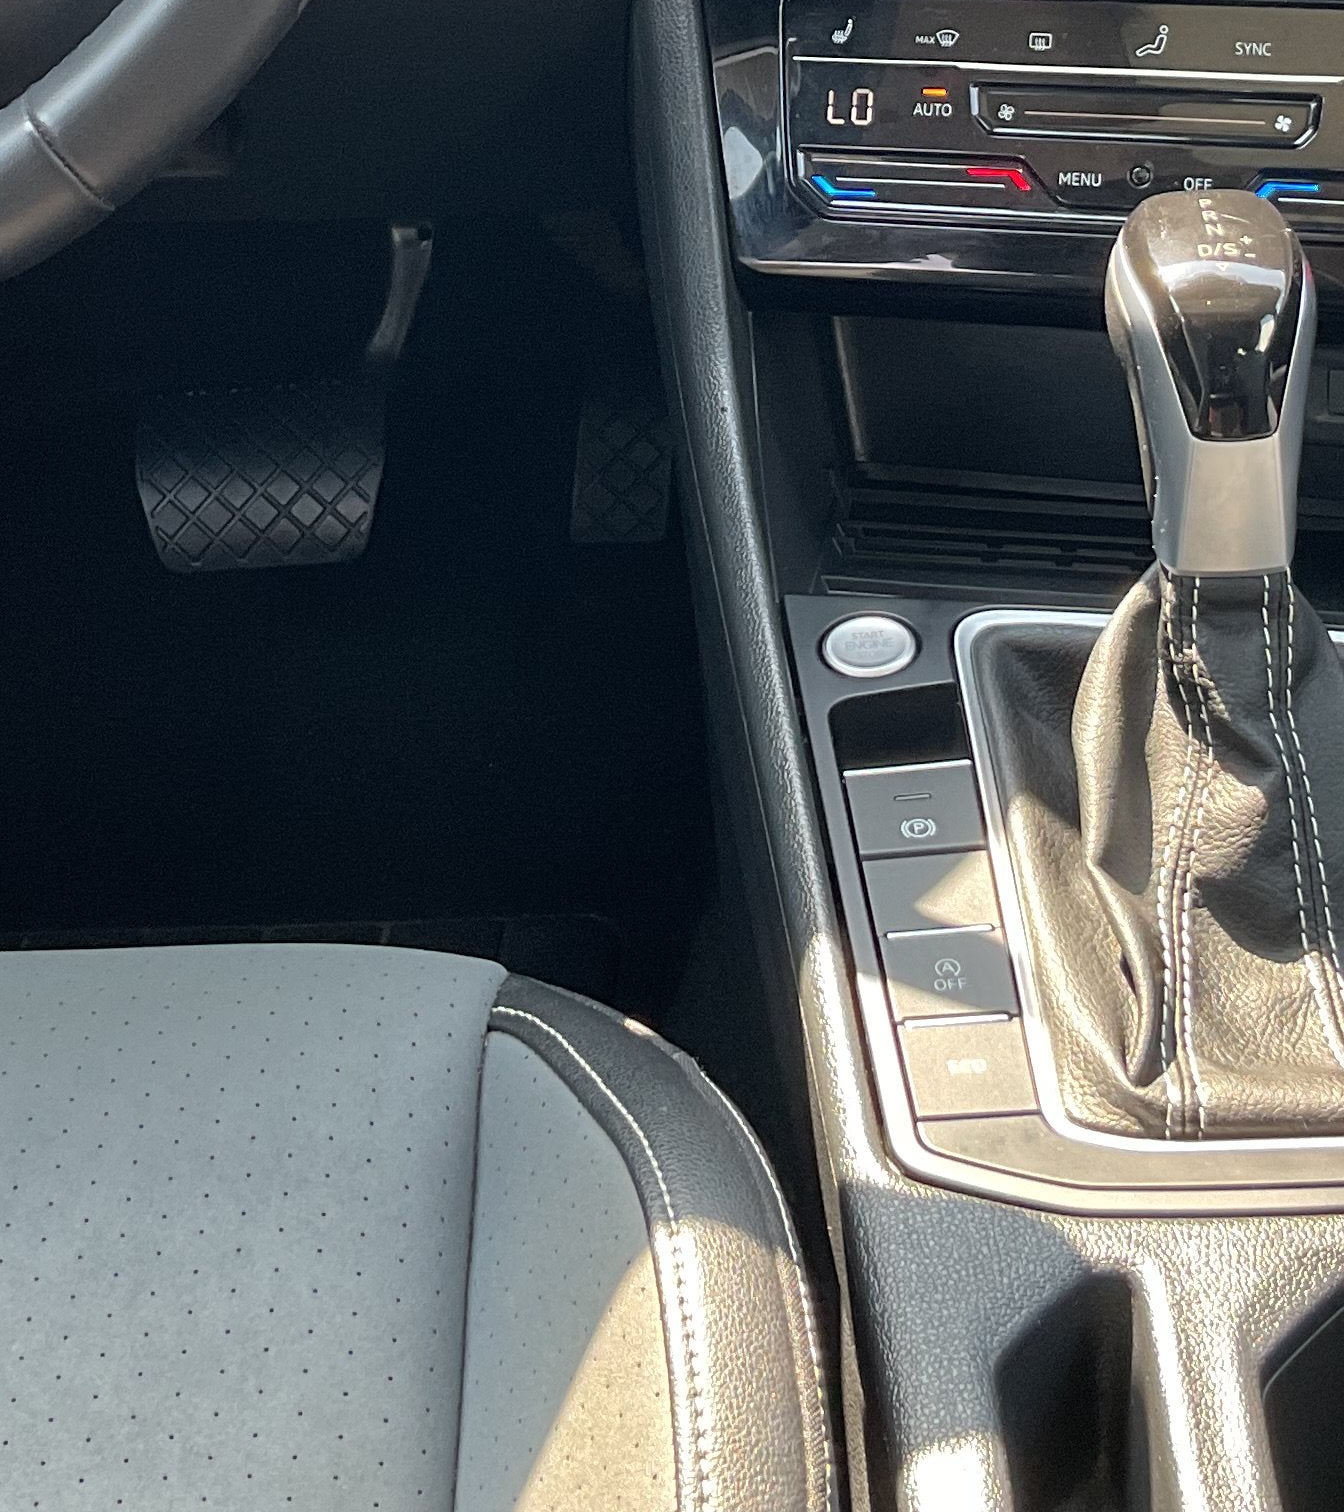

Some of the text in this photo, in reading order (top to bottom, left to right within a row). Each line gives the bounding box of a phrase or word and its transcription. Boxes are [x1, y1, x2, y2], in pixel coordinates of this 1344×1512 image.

[915, 35, 936, 45] MAX
[1234, 41, 1272, 57] SYNC
[913, 103, 953, 117] AUTO
[1058, 172, 1102, 187] MENU
[1183, 177, 1213, 191] OFF
[1202, 210, 1219, 221] R
[1205, 223, 1225, 237] N
[1197, 242, 1241, 258] D/S
[851, 631, 885, 640] START
[844, 637, 896, 651] ENGINE
[933, 977, 968, 992] OFF
